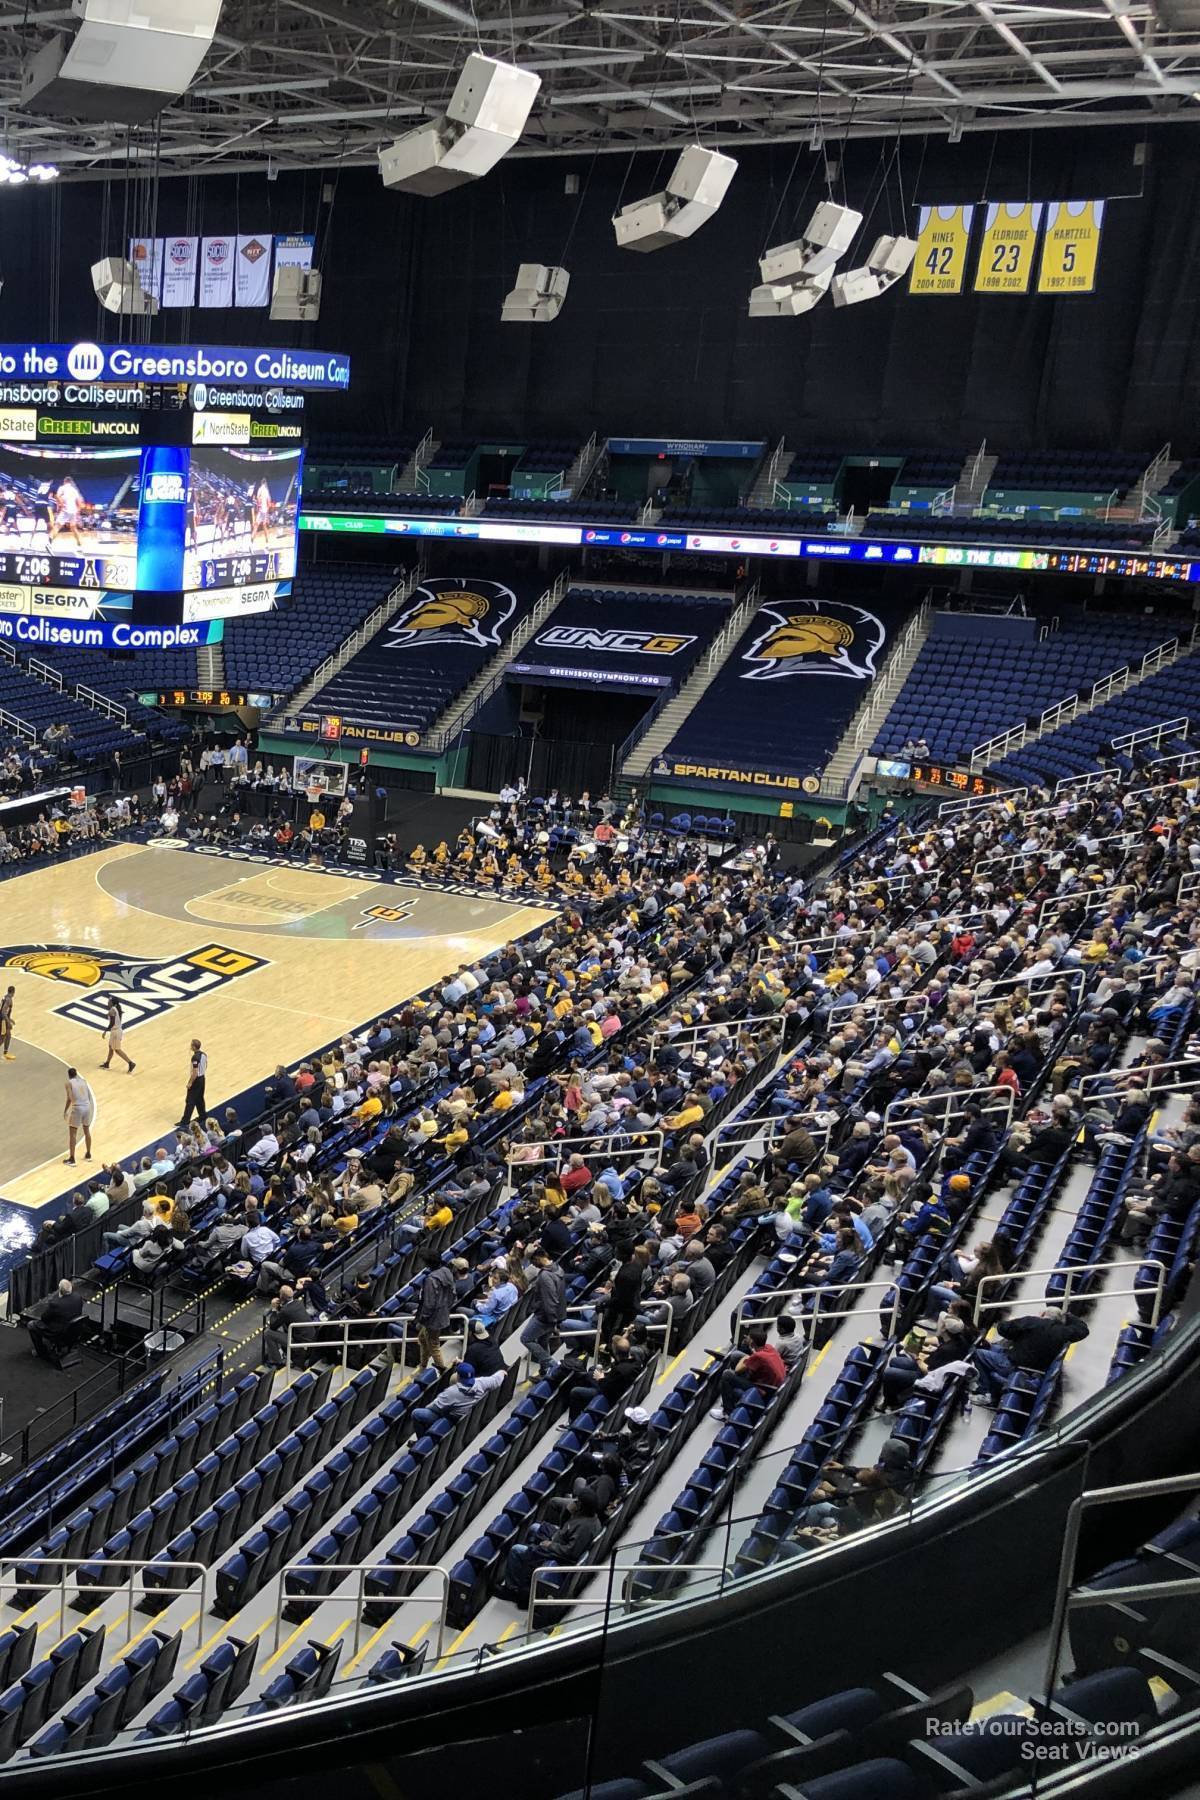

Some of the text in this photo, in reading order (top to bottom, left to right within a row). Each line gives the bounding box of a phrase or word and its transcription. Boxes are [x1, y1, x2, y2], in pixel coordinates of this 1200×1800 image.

[932, 232, 954, 243] HINES
[992, 230, 1029, 241] ELDRIDGE
[1054, 228, 1091, 240] HARTZELL
[925, 247, 954, 275] 42
[991, 245, 1020, 273] 23
[1063, 244, 1077, 272] 5
[916, 279, 934, 288] 2004
[1003, 277, 1021, 287] 2002
[24, 347, 58, 373] the
[110, 350, 247, 377] Greensboro
[255, 354, 324, 380] Coliseum
[64, 385, 143, 404] Coliseum
[209, 388, 304, 409] Greensboro Coliseum
[92, 422, 140, 434] LINCOLN
[210, 421, 249, 435] NorthState
[15, 556, 50, 576] 7:06
[231, 559, 251, 577] 7:06
[1080, 558, 1088, 568] 2
[1108, 560, 1116, 570] 4
[34, 593, 89, 608] SEGRA
[241, 590, 270, 604] SEGRA
[16, 617, 103, 645] Coliseum
[112, 623, 199, 649] Complex
[544, 628, 687, 652] UNCG
[550, 668, 659, 684] GREENSBOROSYMPHONY.ORG
[366, 729, 404, 743] CLUB
[674, 763, 800, 789] SPARTAN CLUB
[194, 845, 561, 909] Greensboro Coliseum
[64, 947, 261, 1031] UNCG
